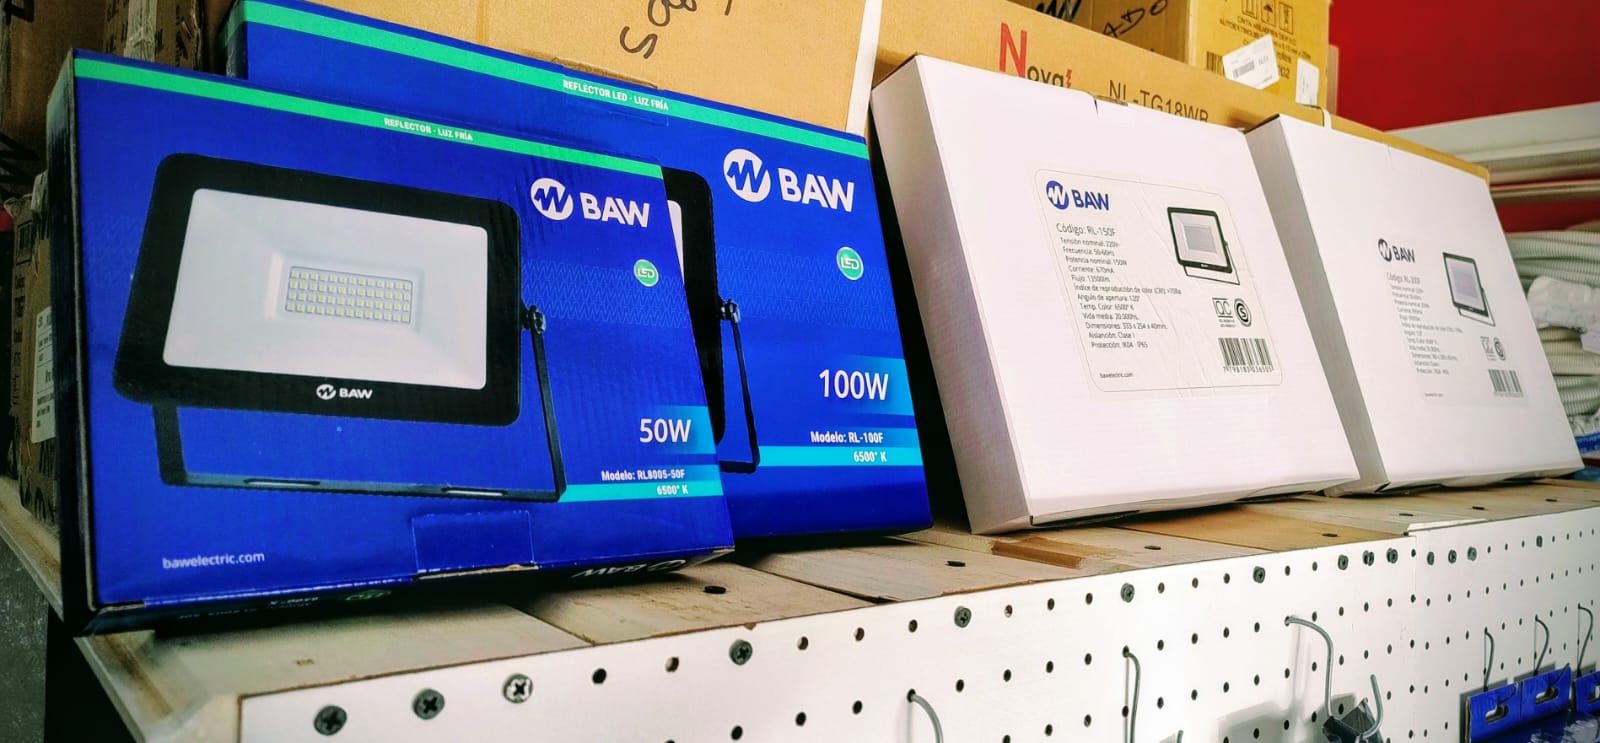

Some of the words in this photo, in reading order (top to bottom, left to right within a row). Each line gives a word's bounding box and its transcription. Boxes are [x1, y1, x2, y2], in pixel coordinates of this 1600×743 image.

[563, 79, 610, 98] REFLECTOR
[612, 90, 628, 102] LED
[633, 95, 650, 106] LUZ
[383, 117, 432, 134] REFLECTOR
[437, 127, 454, 139] LUZ
[778, 168, 855, 213] BAW
[1071, 188, 1110, 211] BAW
[580, 192, 650, 228] BAW
[1055, 222, 1085, 236] Código:
[1392, 245, 1415, 263] BAW
[338, 387, 373, 400] BAW
[819, 369, 889, 401] 100W
[639, 418, 691, 444] 50W
[810, 431, 847, 444] Modelo:
[848, 432, 884, 444] RL-100F
[853, 450, 878, 463] 6500°
[880, 451, 888, 462] K
[600, 470, 636, 481] Modelo:
[636, 469, 686, 480] RL8005-50F
[681, 484, 689, 495] K
[162, 552, 265, 569] bawelectric.com
